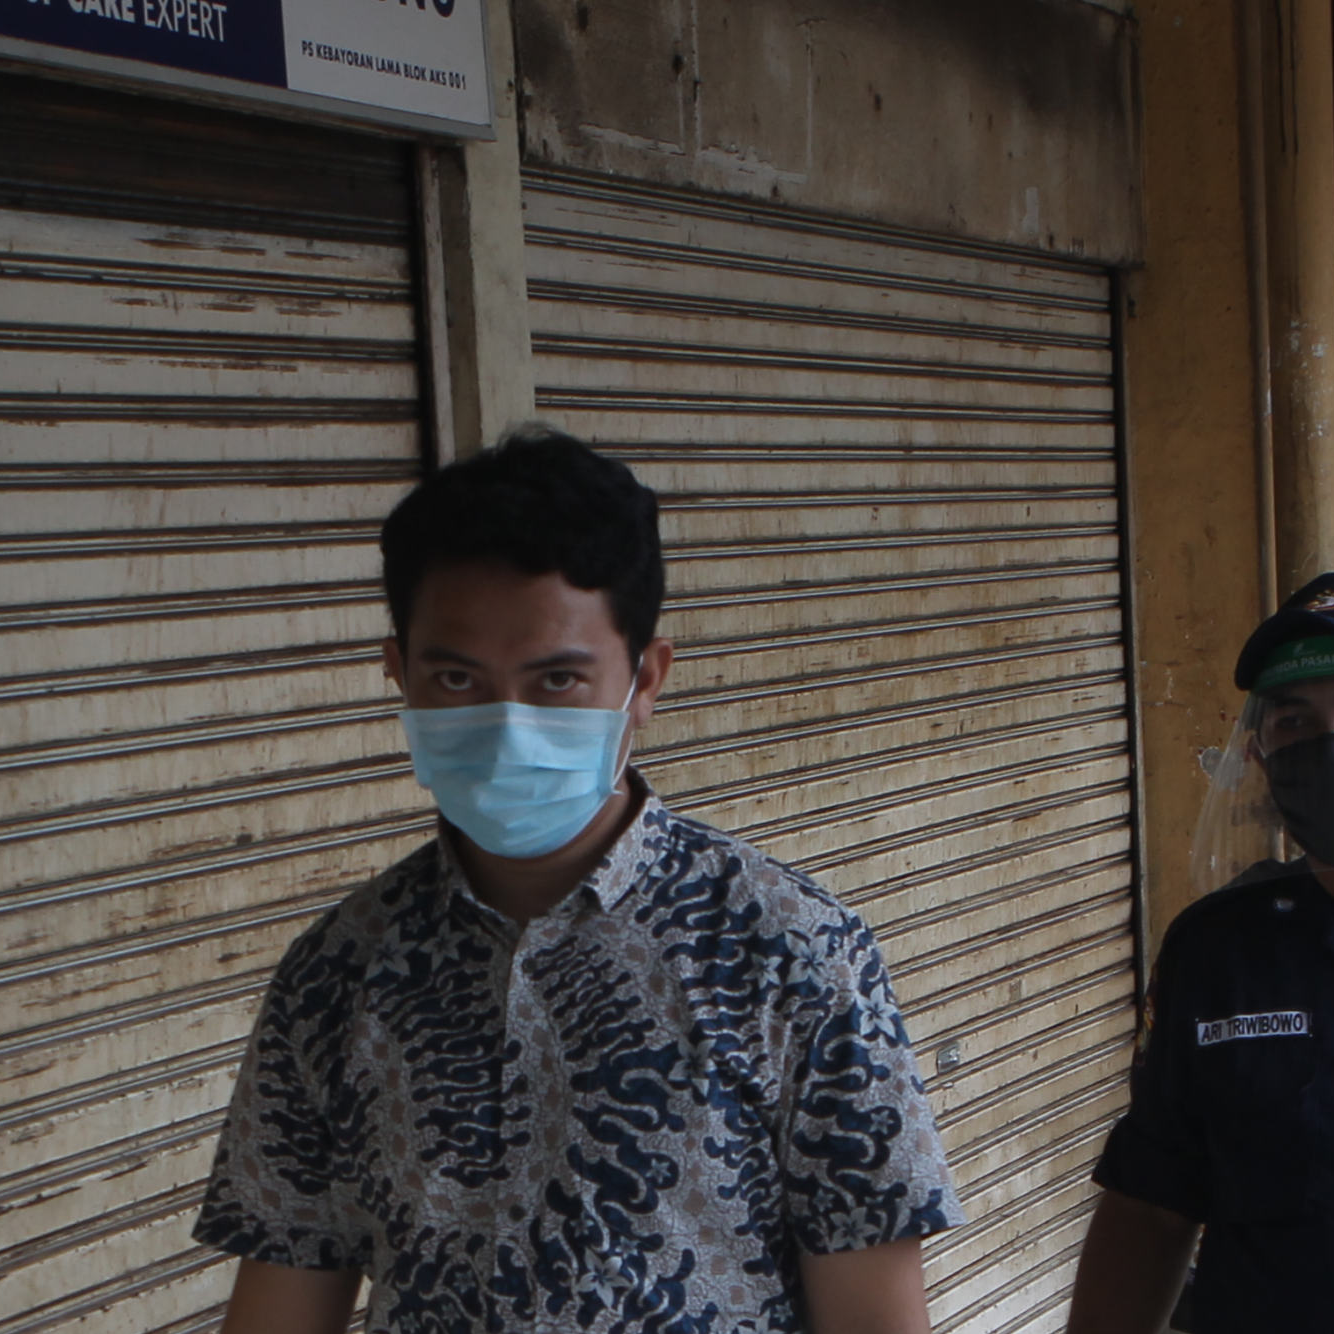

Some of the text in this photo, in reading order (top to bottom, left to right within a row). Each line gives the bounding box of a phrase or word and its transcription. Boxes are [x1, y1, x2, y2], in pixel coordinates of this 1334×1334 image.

[143, 0, 228, 42] EXPERT
[301, 40, 313, 57] PS
[316, 43, 373, 70] KEBAYORAN
[375, 57, 401, 75] LAMA
[403, 64, 426, 81] BLOK
[1200, 1013, 1304, 1043] ARI TRIWIBOWO
